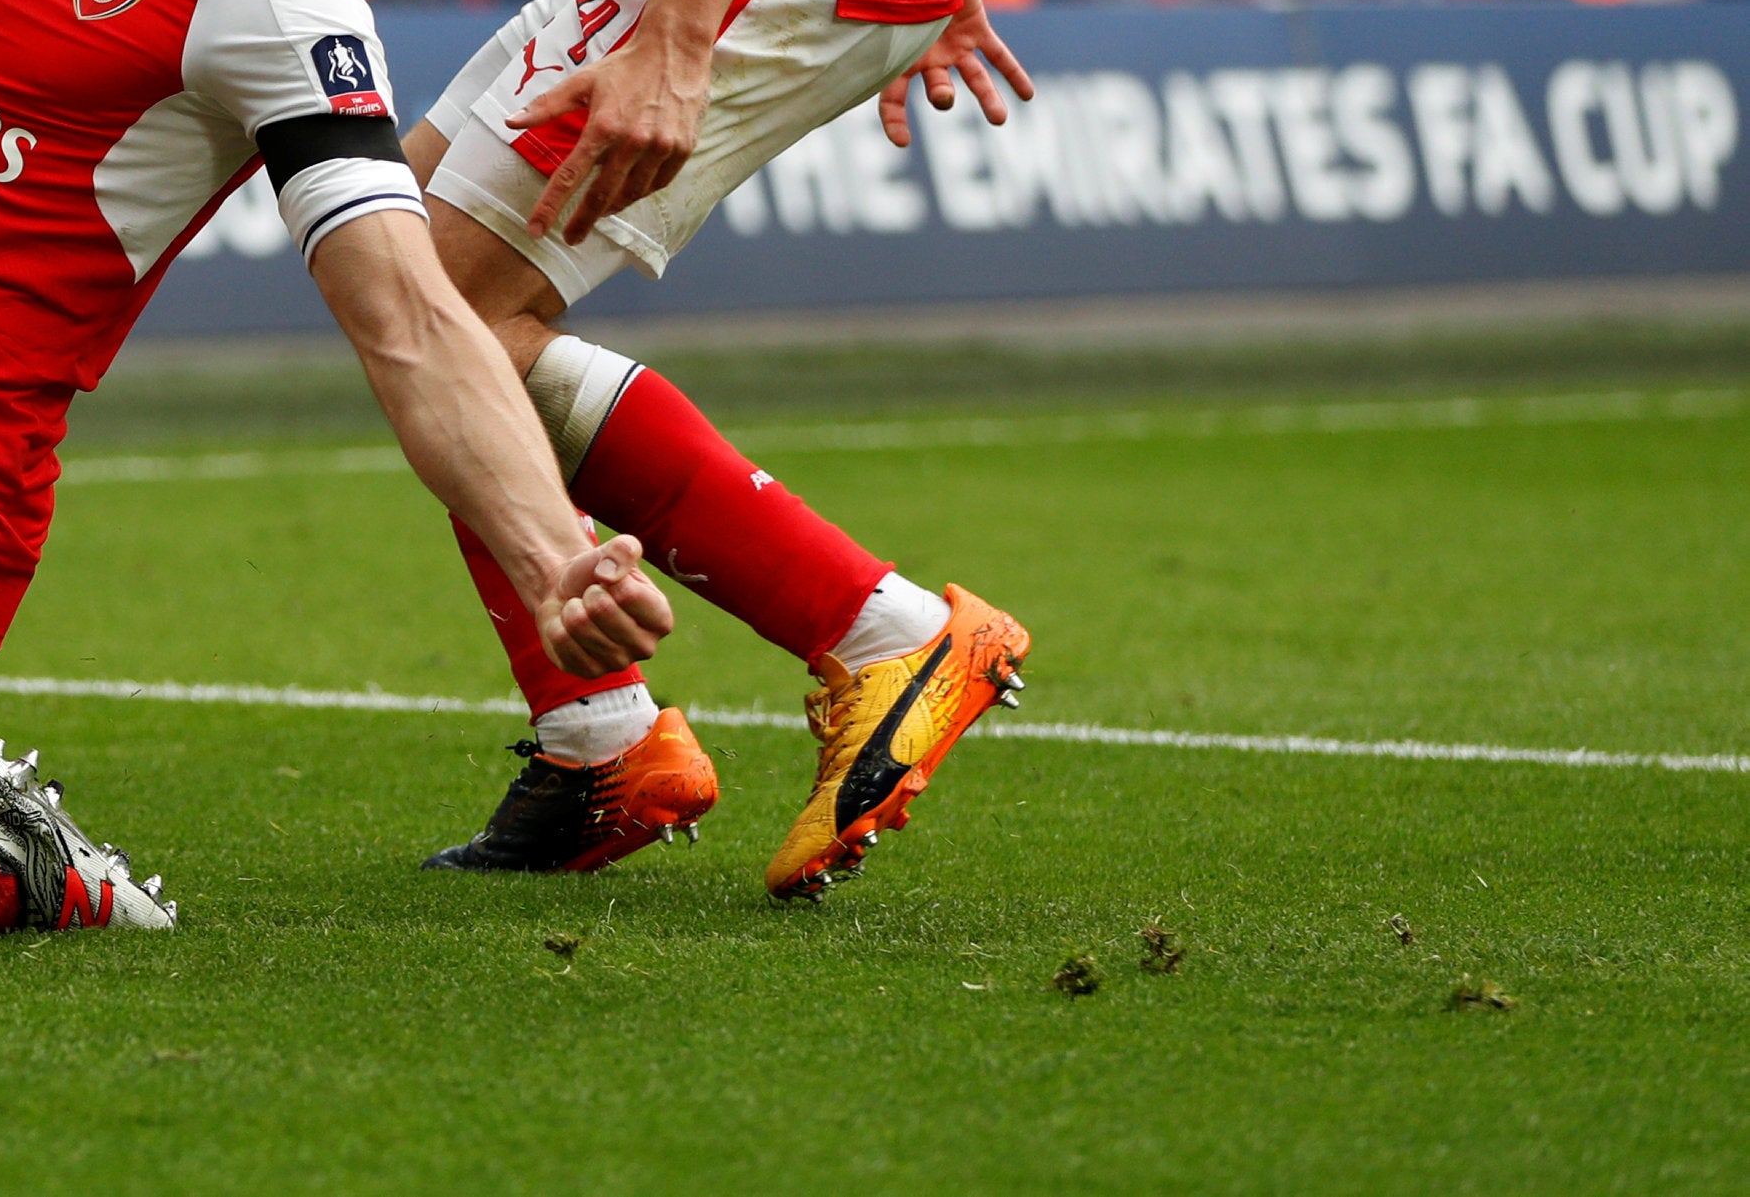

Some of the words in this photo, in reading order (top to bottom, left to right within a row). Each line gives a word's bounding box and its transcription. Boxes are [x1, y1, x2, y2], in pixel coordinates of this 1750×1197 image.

[339, 103, 381, 116] Emirates
[910, 66, 1416, 230] EMIRATES
[1407, 62, 1552, 216] FA
[1546, 58, 1739, 216] CUP
